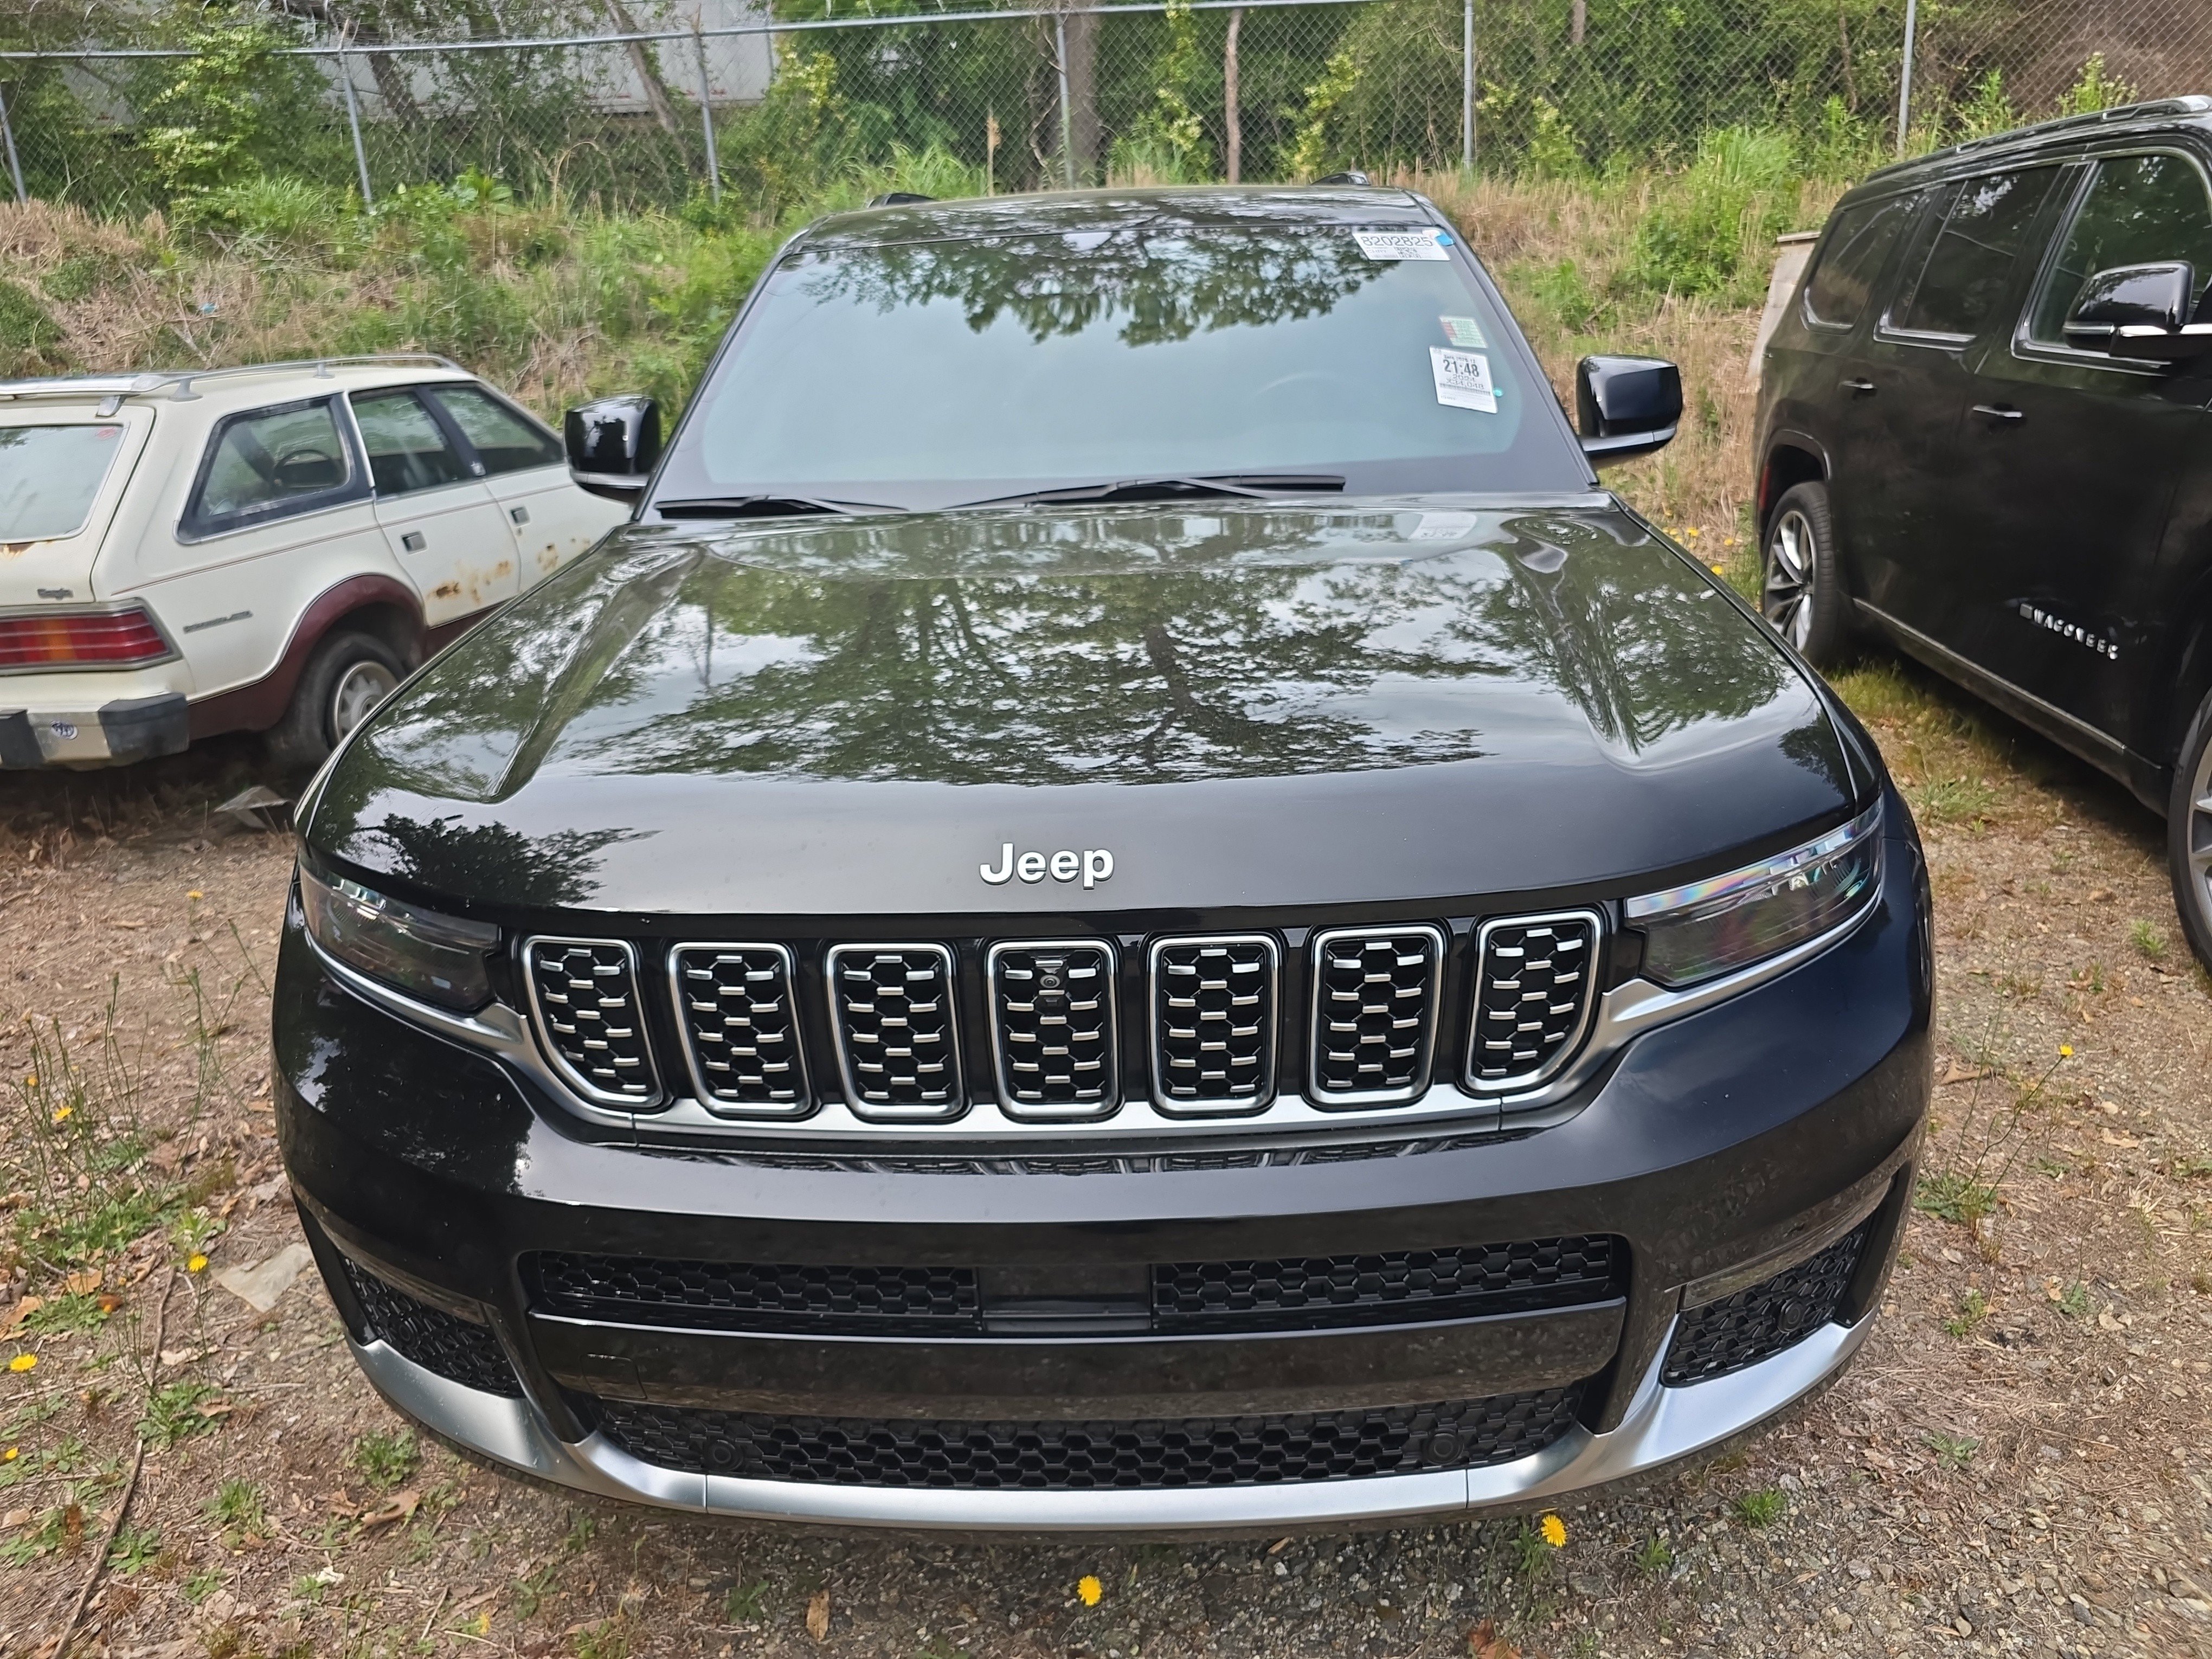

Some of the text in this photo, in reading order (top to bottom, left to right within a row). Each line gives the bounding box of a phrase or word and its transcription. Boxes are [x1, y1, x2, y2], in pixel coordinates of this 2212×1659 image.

[1361, 236, 1433, 247] 8202825
[1443, 359, 1480, 377] 21:48
[2034, 608, 2119, 660] WAGONEER
[979, 842, 1114, 890] Jeep
